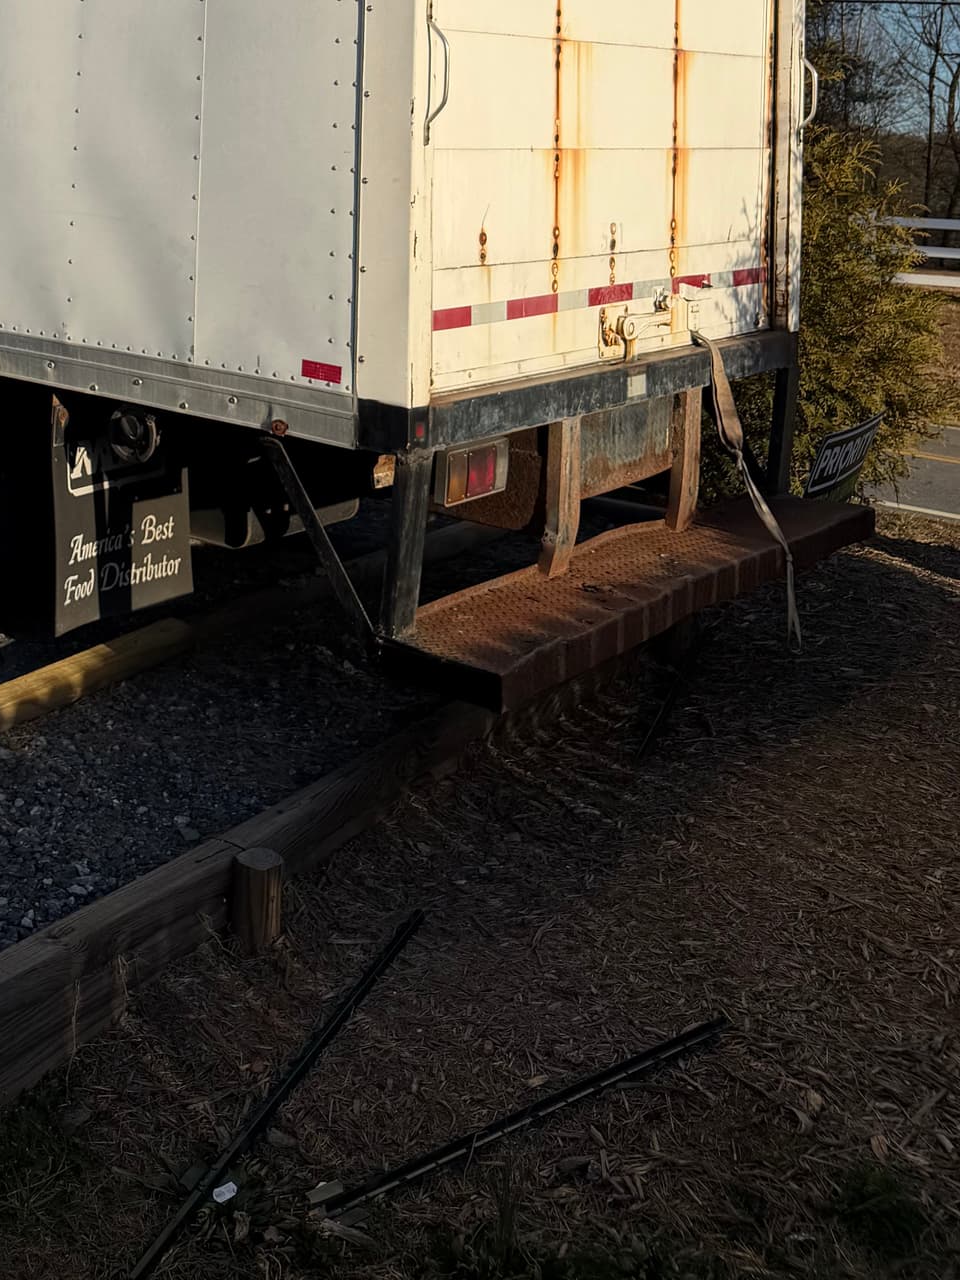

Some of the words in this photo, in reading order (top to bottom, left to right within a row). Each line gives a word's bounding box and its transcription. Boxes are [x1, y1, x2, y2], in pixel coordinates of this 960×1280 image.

[141, 514, 175, 545] Best
[63, 568, 95, 606] Food
[100, 552, 182, 592] Distributor
